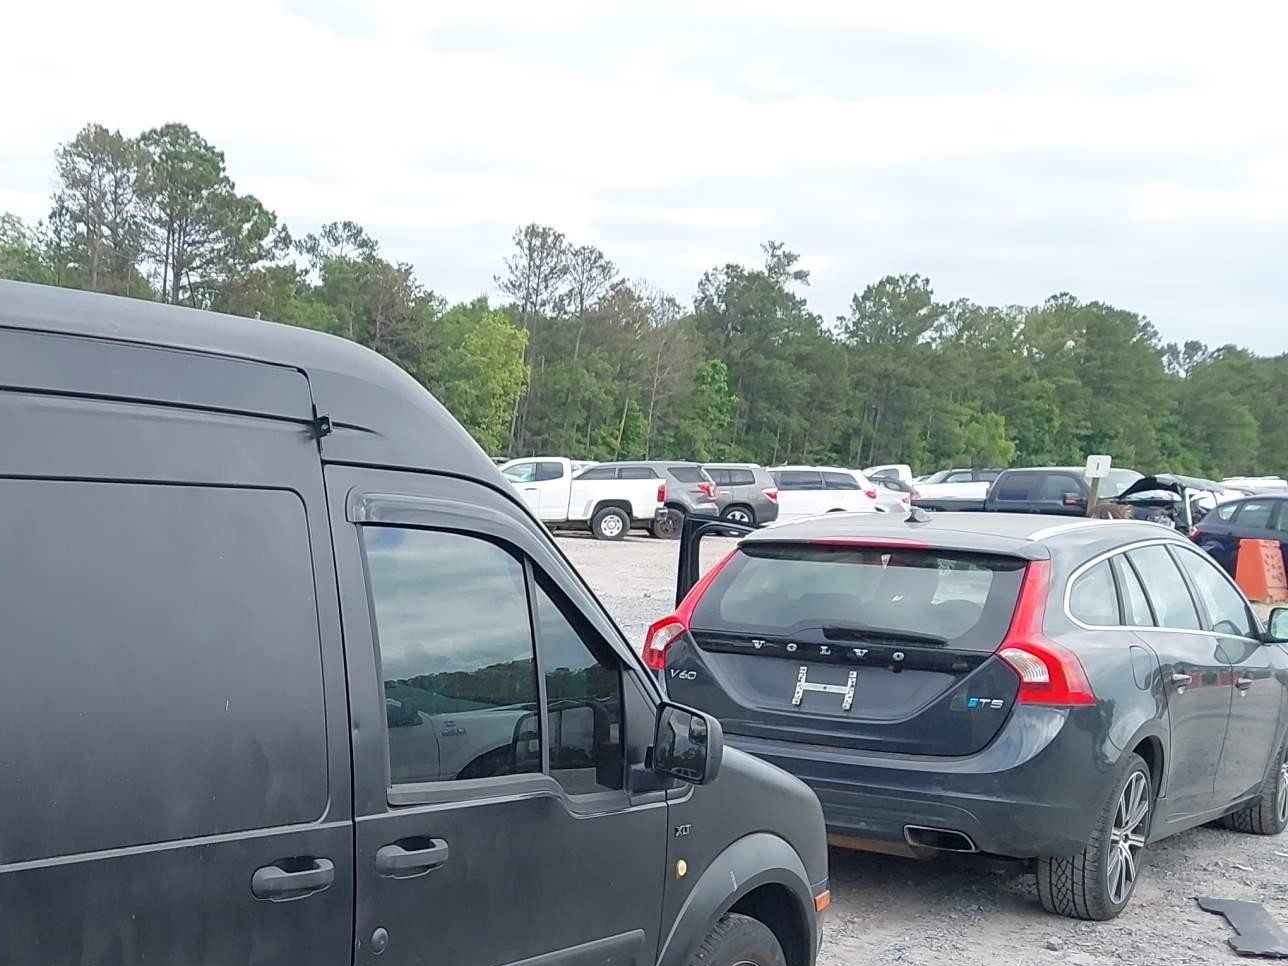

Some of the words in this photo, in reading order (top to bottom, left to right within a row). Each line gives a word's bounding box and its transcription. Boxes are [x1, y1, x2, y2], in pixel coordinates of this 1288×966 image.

[752, 639, 905, 661] VOLVO
[669, 668, 697, 680] V60
[674, 824, 692, 837] XLT
